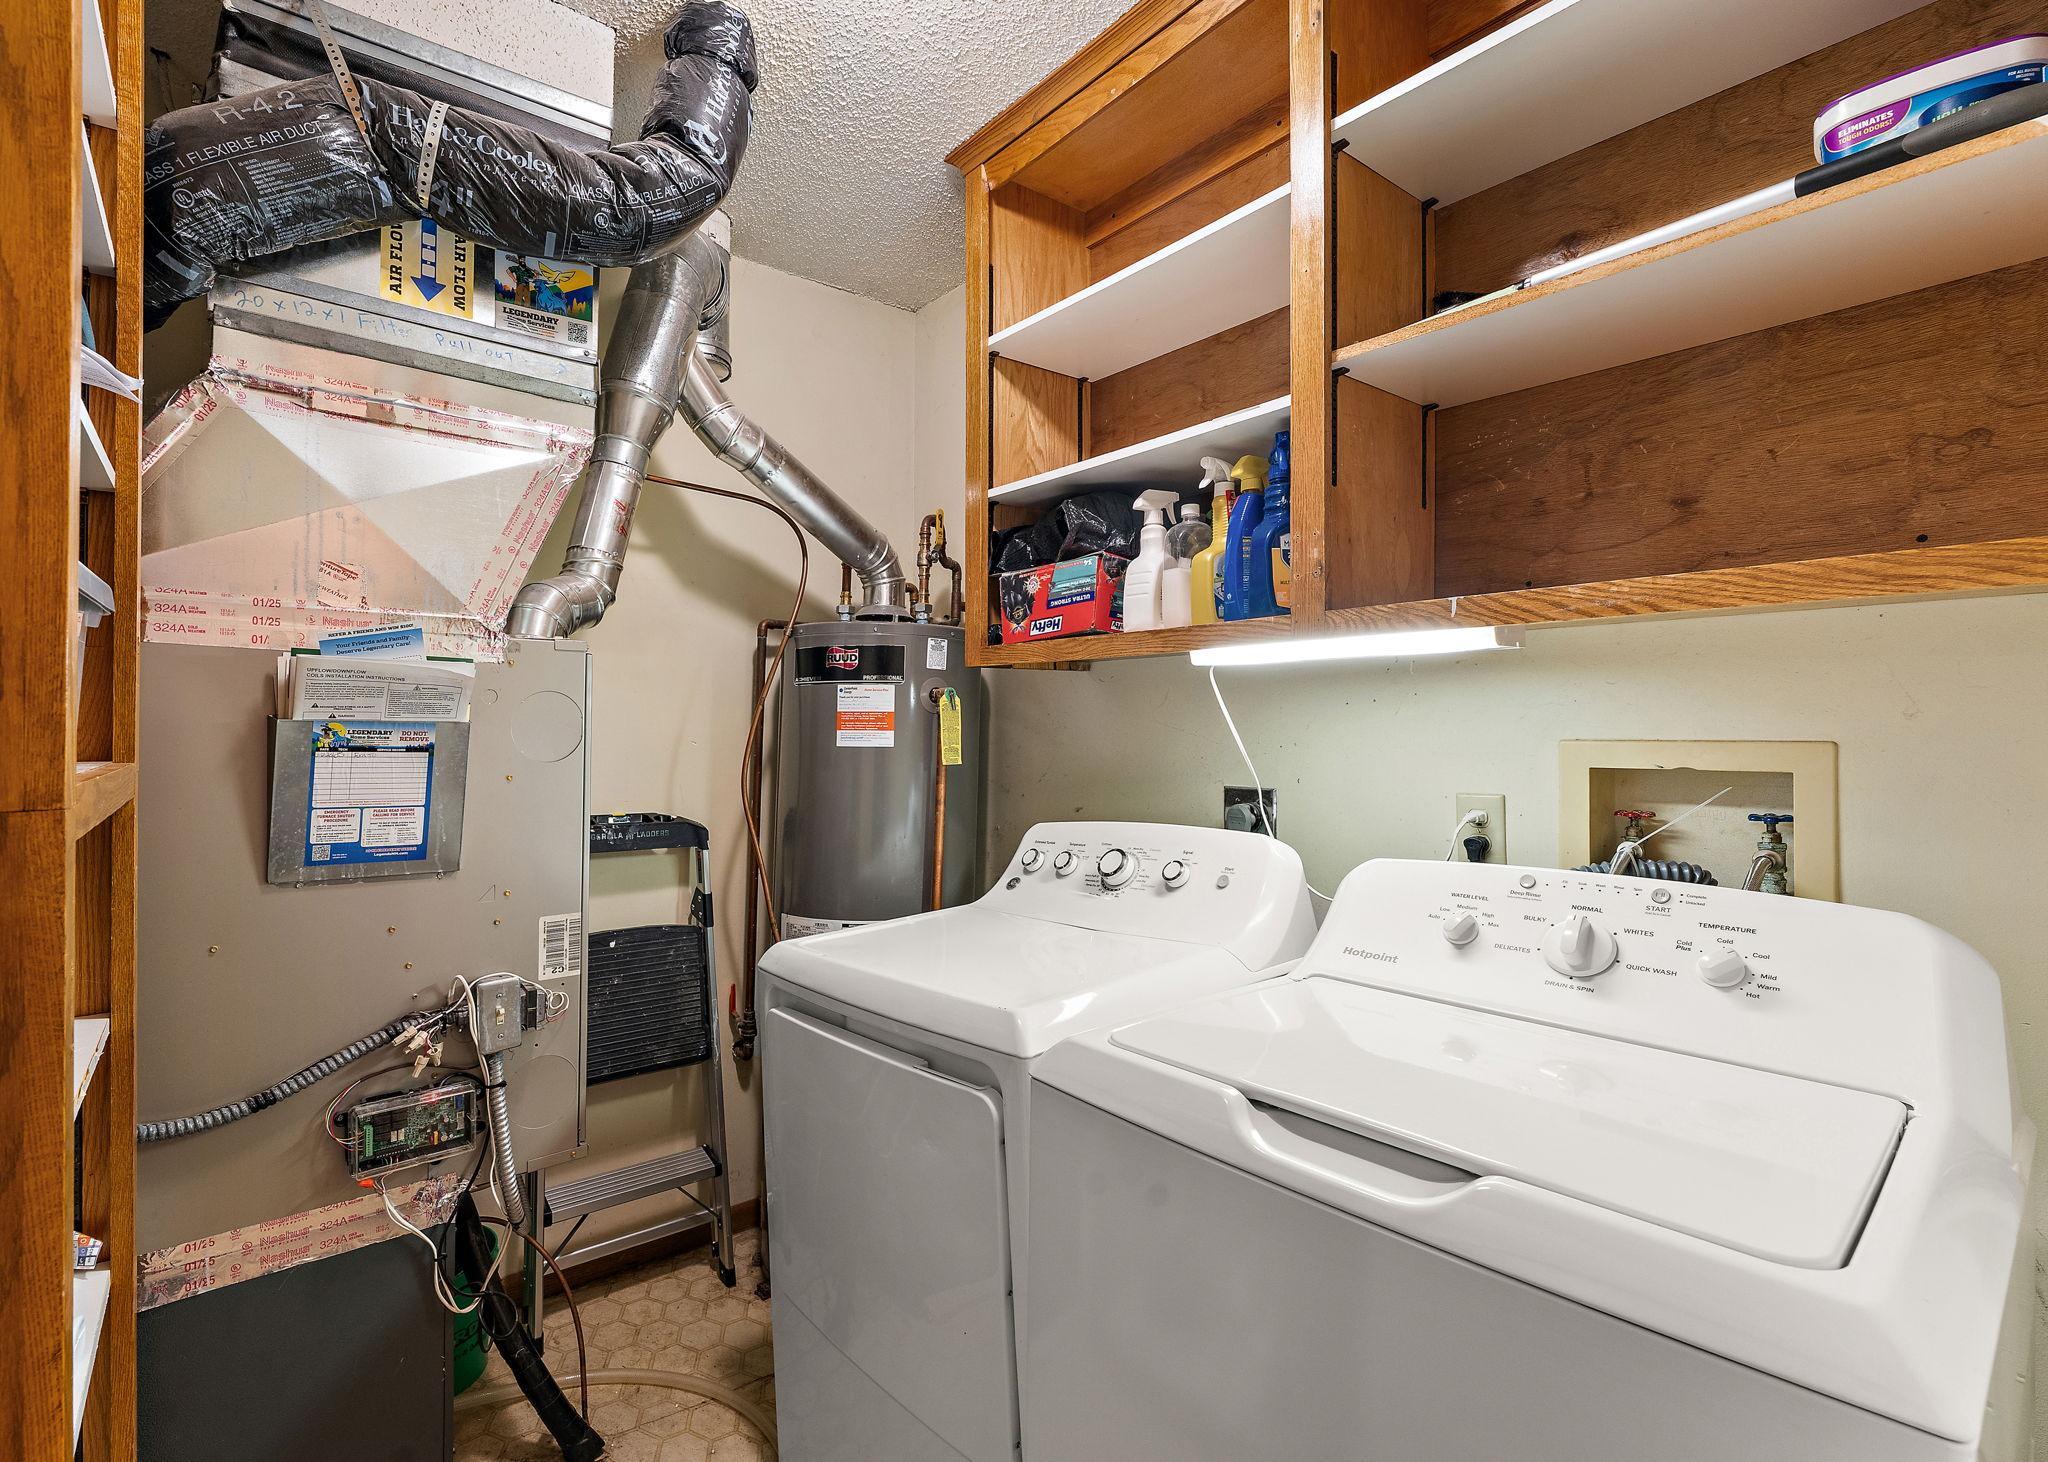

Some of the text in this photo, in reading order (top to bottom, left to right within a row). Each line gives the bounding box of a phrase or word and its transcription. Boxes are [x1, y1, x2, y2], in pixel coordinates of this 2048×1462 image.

[211, 91, 304, 124] R-4.2
[1837, 109, 1894, 138] ELIMINATES
[390, 102, 559, 181] Hat&Cooley
[1838, 130, 1862, 145] TOUGH
[144, 161, 175, 187] ASS
[176, 156, 186, 169] 1
[186, 138, 258, 165] FLEXIBLE
[259, 129, 285, 146] AIR
[283, 120, 322, 139] DUCT
[680, 173, 705, 193] DUCT
[389, 264, 403, 295] AIR
[453, 235, 467, 311] AIR FLOW
[234, 290, 264, 307] 20
[293, 302, 317, 316] 12
[434, 332, 472, 351] Pull
[502, 306, 560, 326] LEGENDARY
[527, 319, 556, 330] Services
[324, 377, 352, 388] 324A
[174, 387, 198, 408] 01/25
[324, 392, 352, 405] 324A
[194, 399, 218, 422] 01/25
[533, 486, 550, 509] 324A
[548, 495, 563, 517] 324A
[252, 597, 281, 608] 01/25
[477, 595, 492, 617] 324A
[1050, 593, 1091, 606] ULTRA STRONG
[154, 603, 187, 614] 324A
[153, 623, 186, 634] 324A
[252, 616, 281, 627] 01/25
[323, 616, 373, 627] Nashua
[1032, 618, 1061, 633] Hefty
[363, 643, 394, 652] Legendary
[396, 640, 411, 648] Care!
[827, 653, 858, 662] RUUD
[1451, 892, 1471, 900] WATER
[1509, 889, 1524, 898] Deep
[1571, 904, 1603, 914] NORMAL
[1645, 905, 1671, 913] START
[1523, 914, 1547, 922] BULKY
[1624, 928, 1654, 937] WHITES
[1698, 922, 1757, 934] TEMPERATURE
[1494, 943, 1531, 953] DELICATES
[1716, 937, 1734, 945] Cold
[1342, 946, 1399, 964] Hotpoint
[1752, 952, 1770, 960] Cool
[1626, 963, 1678, 977] QUICK WASH
[1760, 973, 1777, 981] Mild
[1544, 979, 1568, 989] DRAIN
[1576, 985, 1595, 993] SPIN
[1756, 983, 1781, 992] Warm
[1746, 991, 1761, 1000] Hot
[319, 1216, 347, 1231] 324A
[259, 1227, 310, 1246] Nashua
[319, 1234, 348, 1249] 324A
[184, 1238, 215, 1254] 01/25
[259, 1245, 311, 1265] Nashua
[184, 1275, 215, 1292] 01/25
